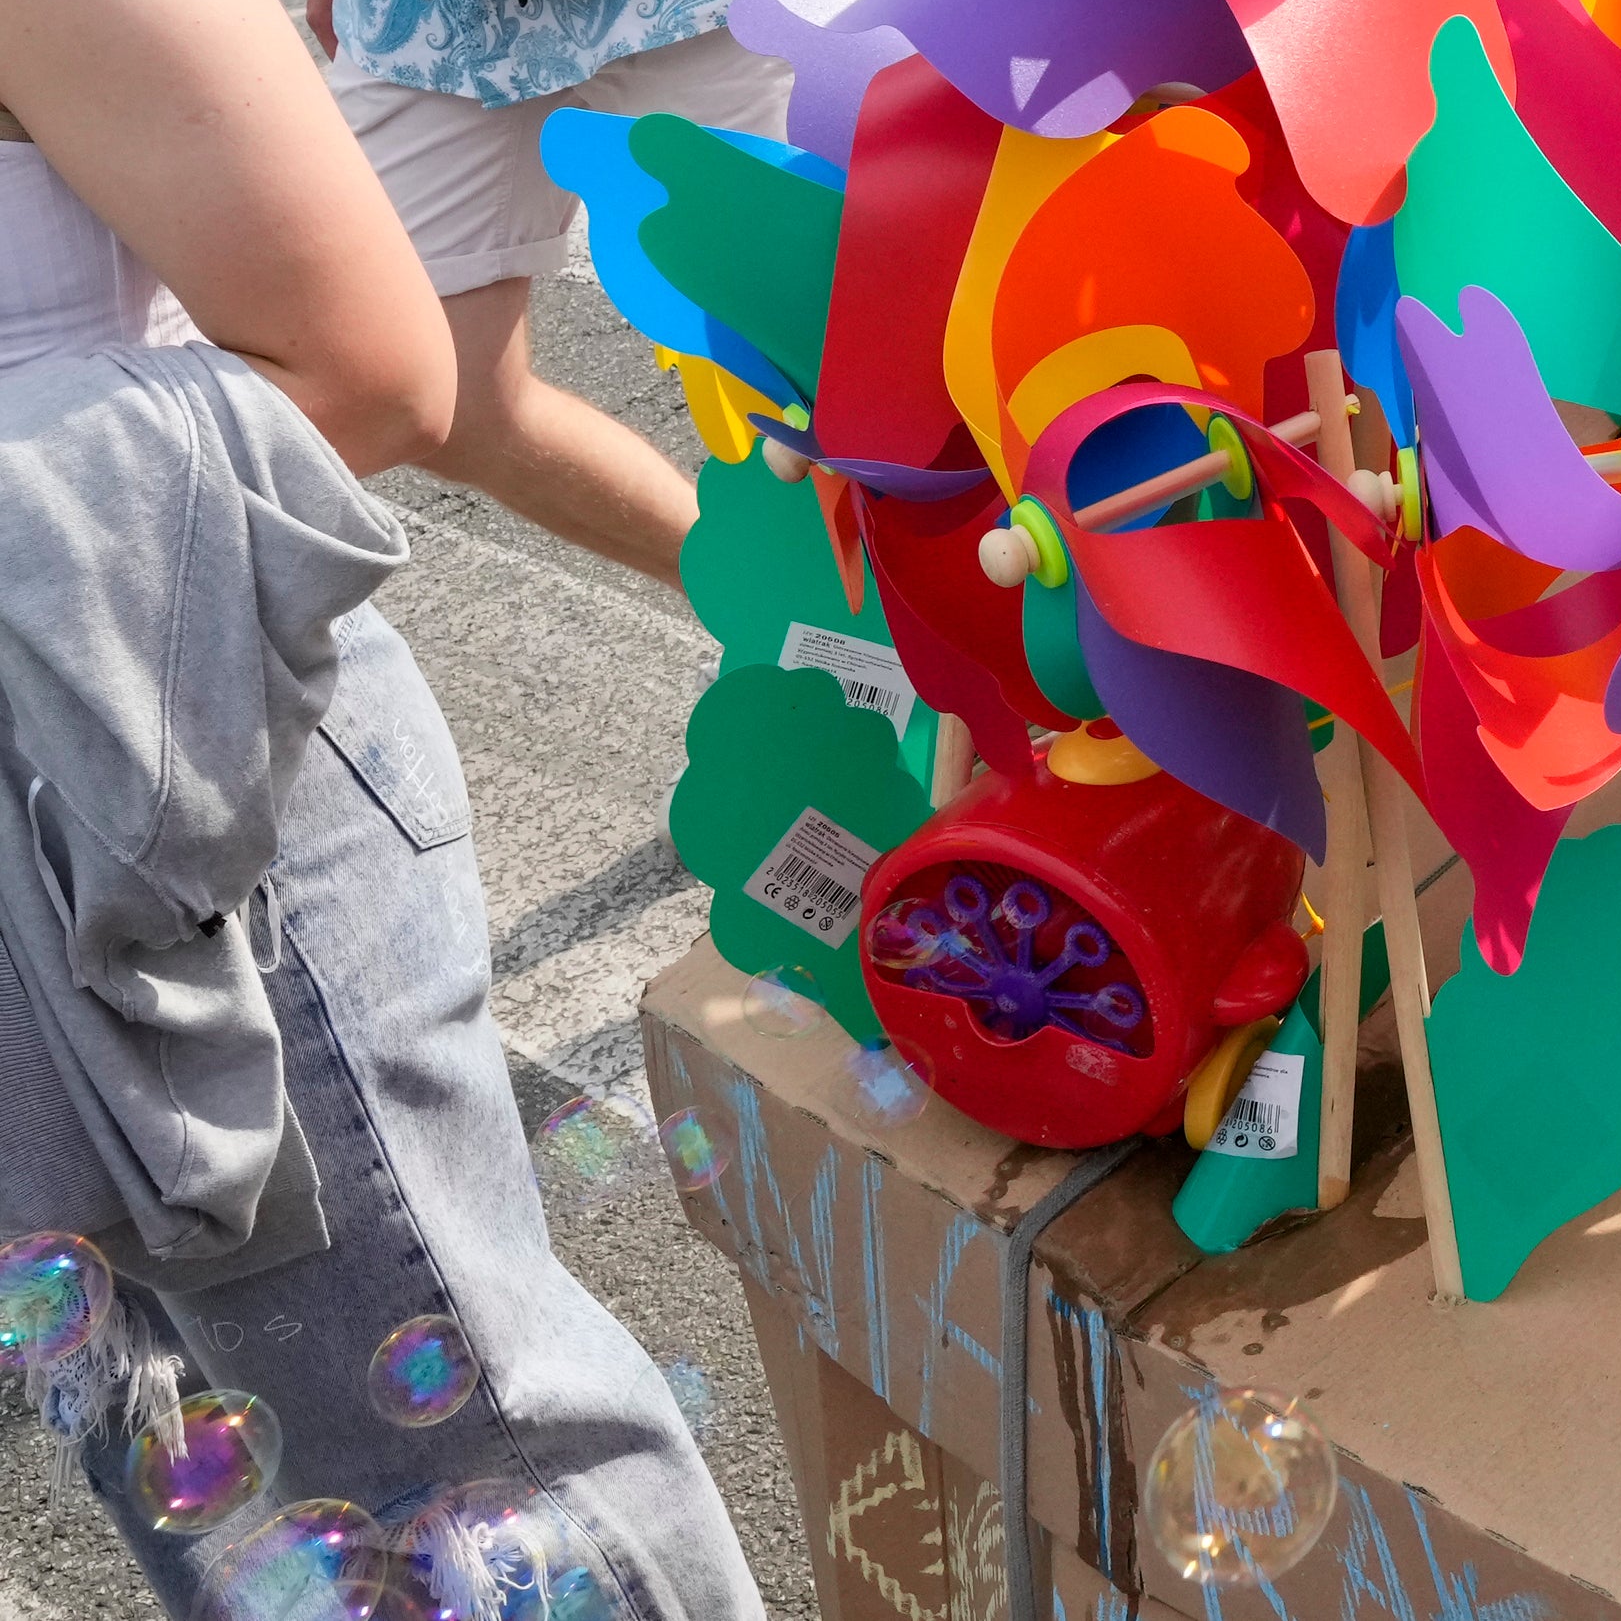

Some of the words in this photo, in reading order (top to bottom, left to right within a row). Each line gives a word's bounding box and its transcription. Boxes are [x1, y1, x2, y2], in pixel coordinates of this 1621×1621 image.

[766, 866, 773, 875] 2
[775, 872, 810, 898] 023518
[809, 894, 844, 919] 205055
[1231, 1119, 1273, 1134] 205086
